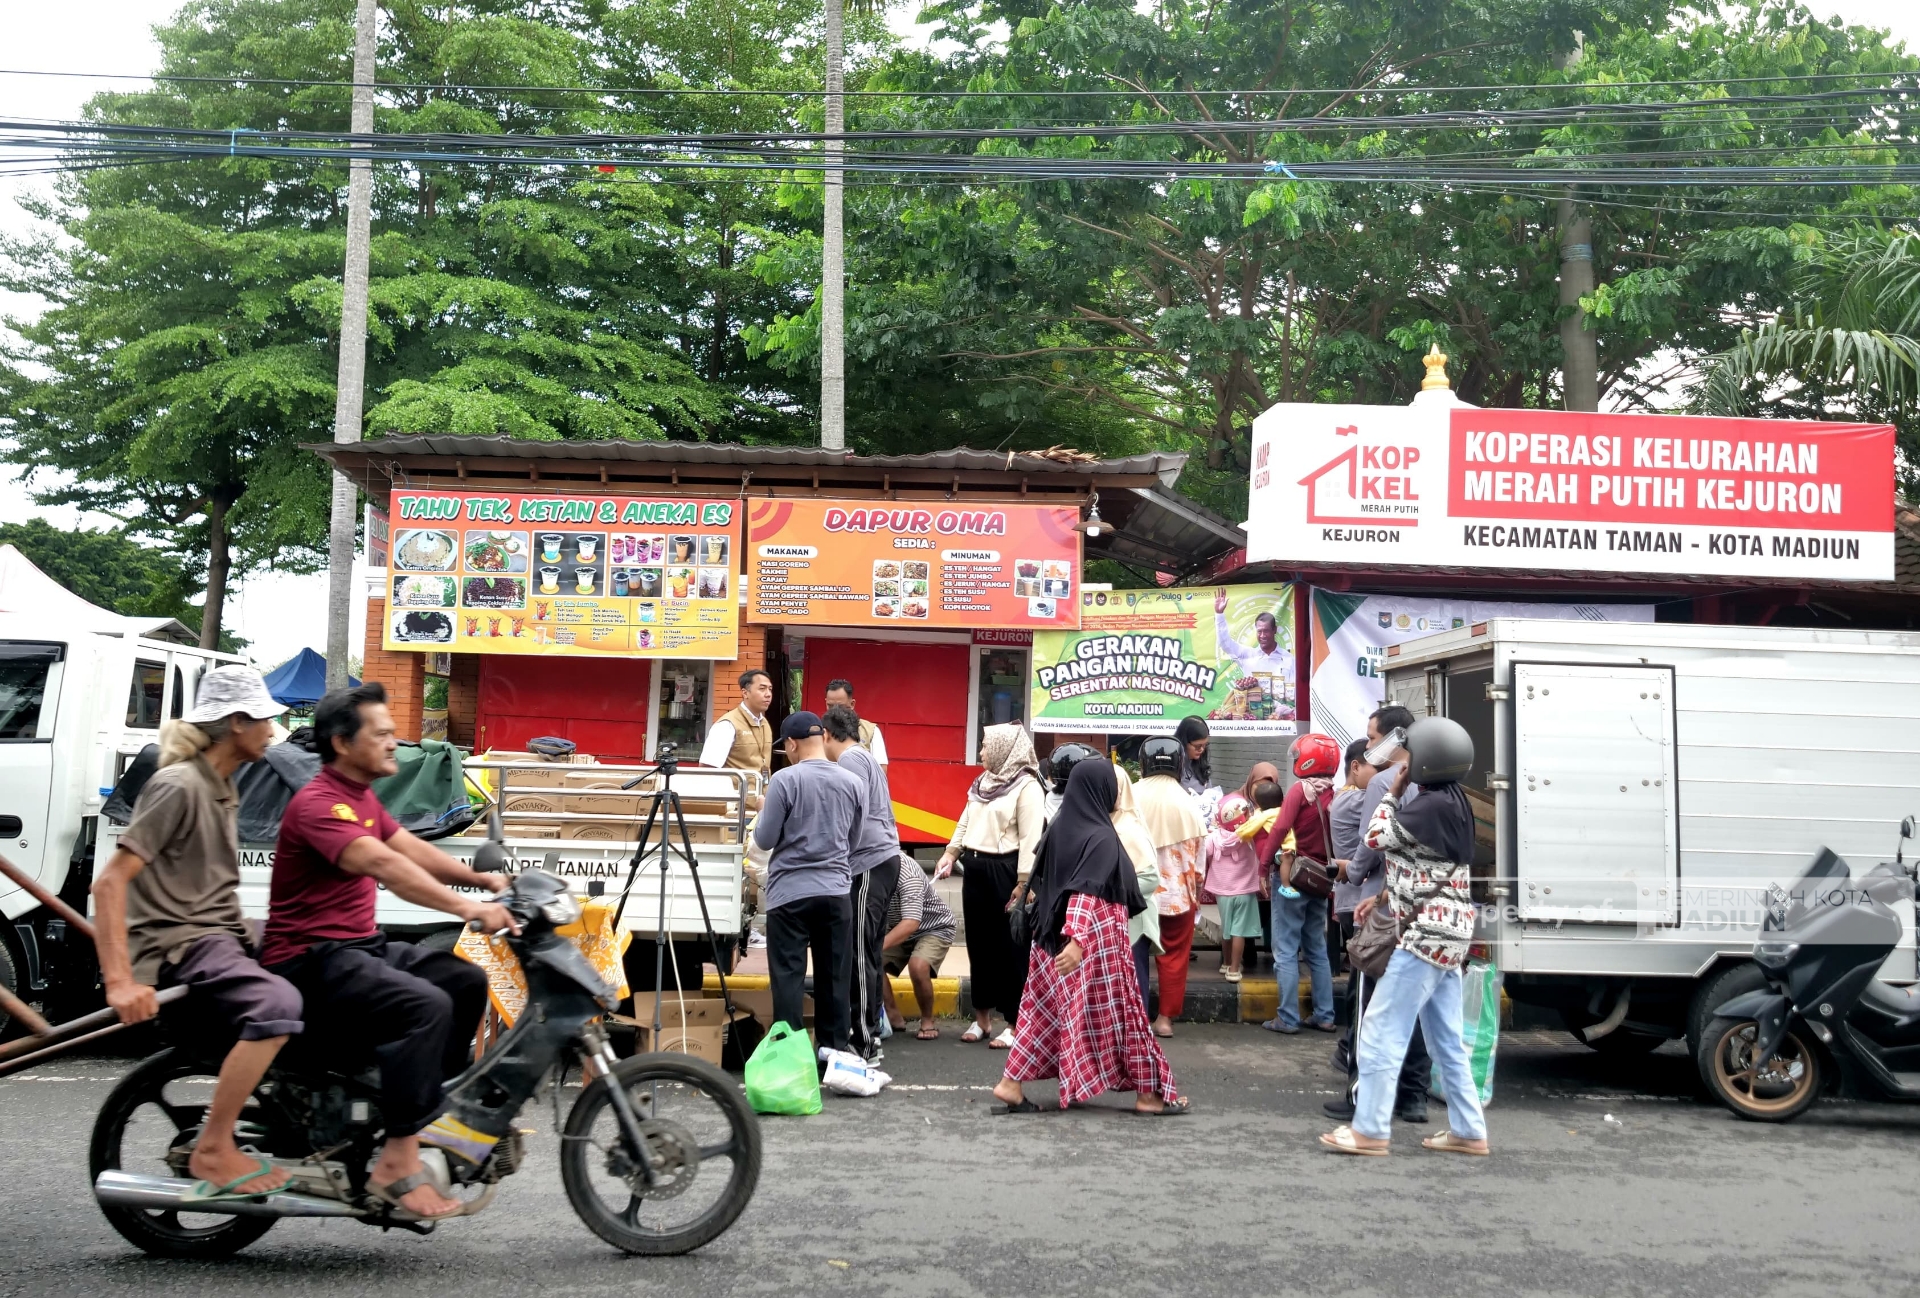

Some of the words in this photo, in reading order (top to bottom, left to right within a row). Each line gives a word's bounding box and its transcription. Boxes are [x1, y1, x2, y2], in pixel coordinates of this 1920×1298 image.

[1362, 445, 1421, 470] KOP
[1465, 431, 1622, 467] KOPERASI
[1633, 437, 1818, 474] KELURAHAN
[1361, 476, 1420, 500] KEL
[1464, 470, 1578, 504] MERAH
[1590, 475, 1684, 508] PUTIH
[1697, 478, 1842, 514] KEJURON
[399, 497, 462, 520] TAHU
[465, 498, 513, 522] TEK,
[518, 499, 596, 523] KETAN
[598, 502, 617, 523] &
[622, 502, 697, 525] ANEKA
[701, 503, 732, 526] ES
[1360, 504, 1391, 513] MERAH
[1394, 505, 1419, 514] PUTIH
[824, 508, 932, 533] DAPUR
[934, 511, 1006, 535] OMA
[893, 538, 930, 549] SEDIA
[1322, 528, 1400, 542] KEJURON
[1464, 525, 1598, 550] KECAMATAN
[1606, 530, 1682, 553] TAMAN
[1708, 534, 1764, 556] KOTA
[1772, 537, 1860, 560] MADIUN
[1161, 592, 1182, 601] bulog
[976, 631, 1033, 643] KEJURON
[1076, 635, 1181, 660] GERAKAN
[1038, 655, 1134, 688] PANGAN
[1137, 655, 1217, 690] MURAH
[1050, 676, 1129, 701] SERENTAK
[1131, 676, 1205, 703] NASIONAL
[1084, 704, 1117, 715] KOTA
[1120, 704, 1163, 715] MADIUN
[580, 831, 613, 839] MINYAKITA
[520, 859, 618, 878] PETANIAN
